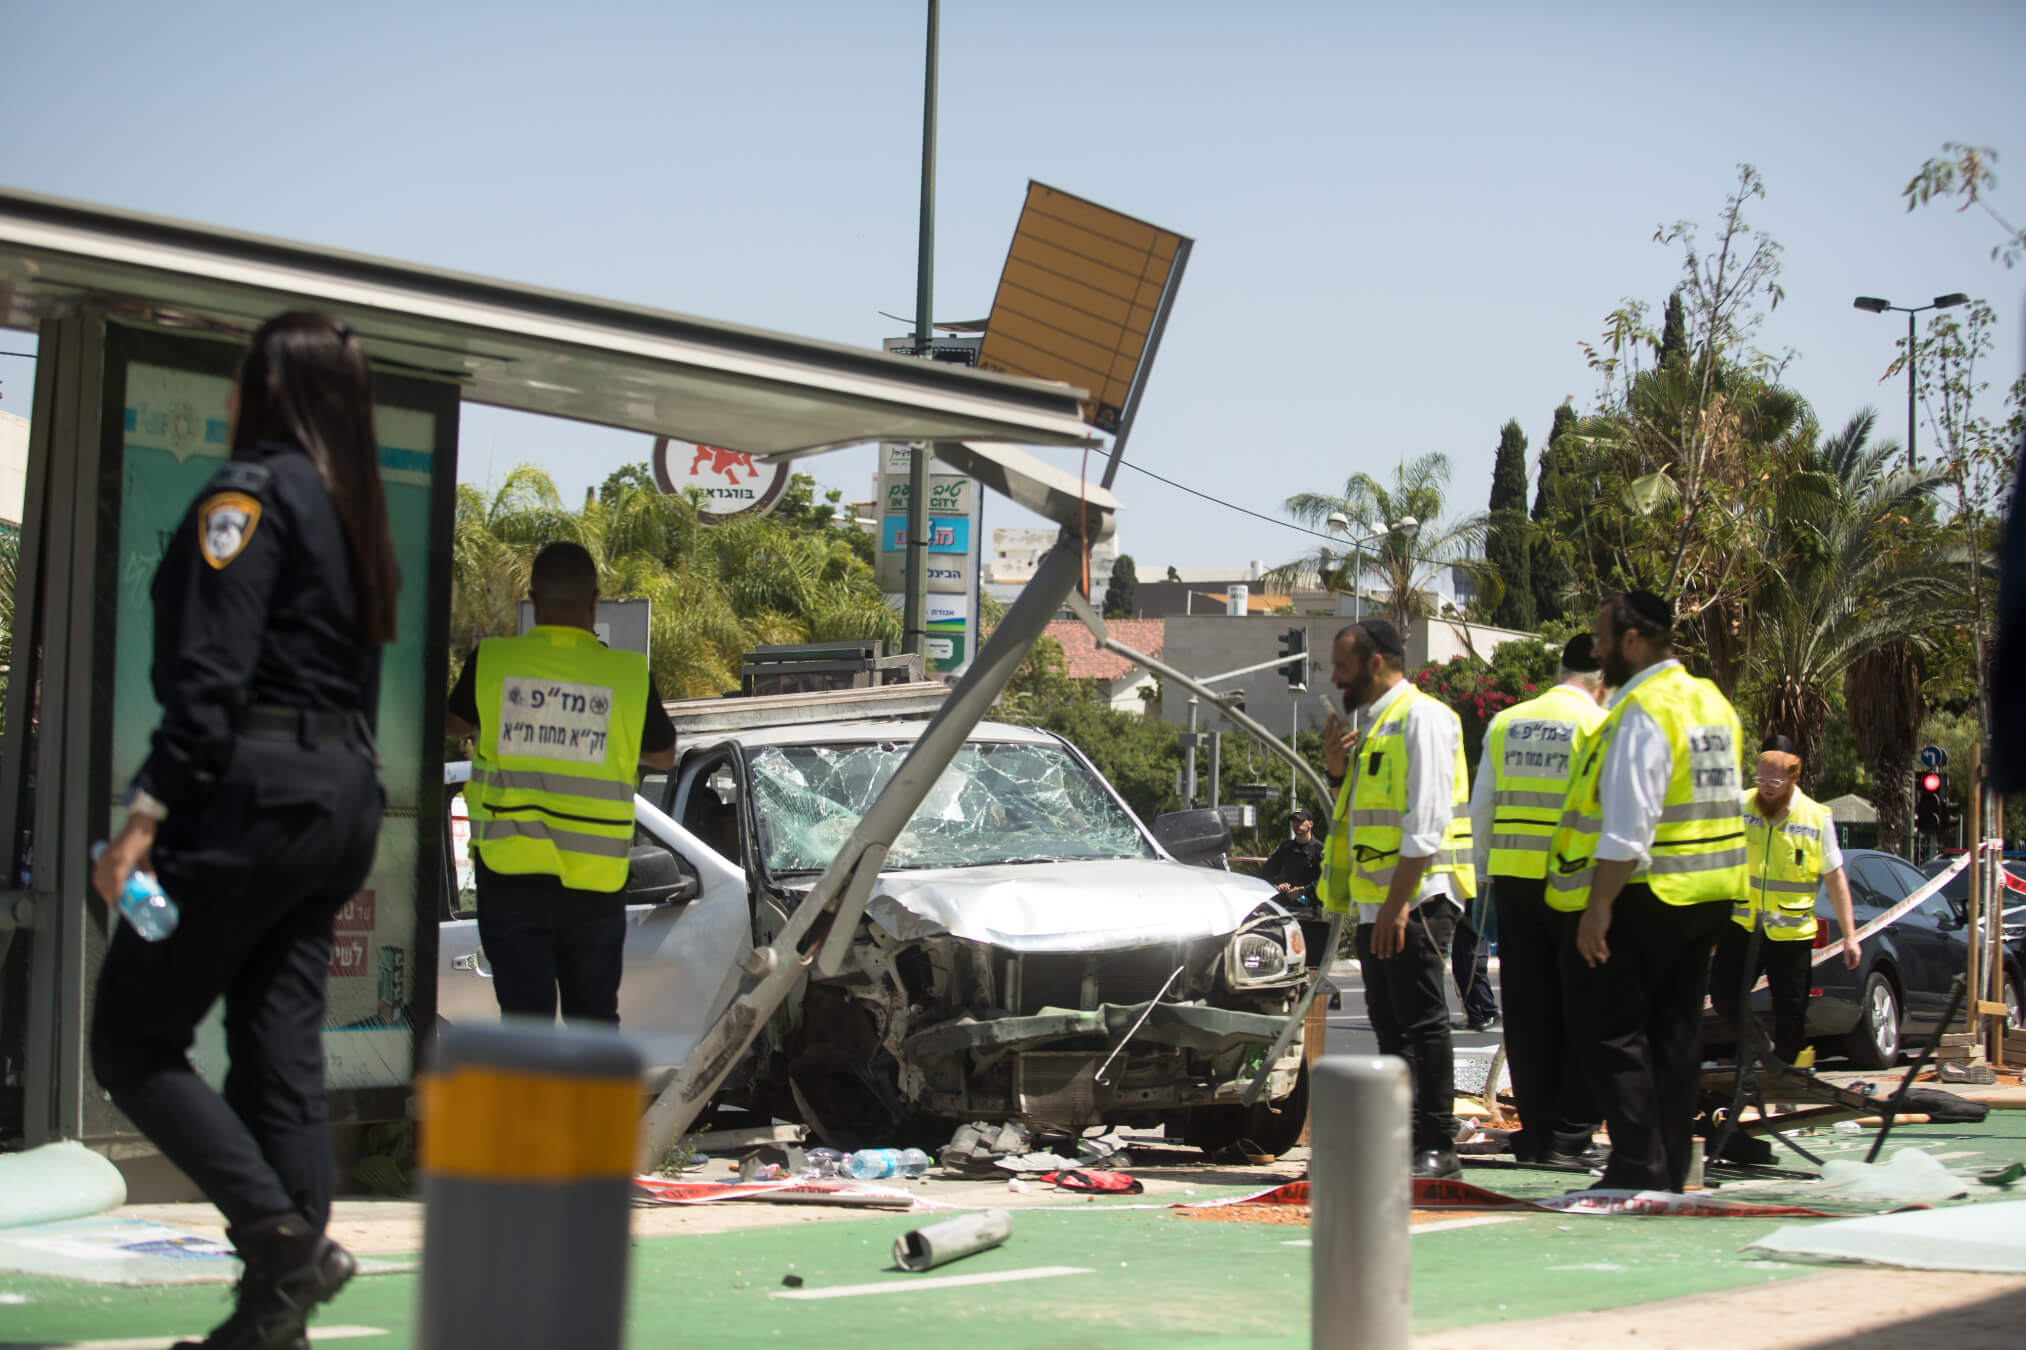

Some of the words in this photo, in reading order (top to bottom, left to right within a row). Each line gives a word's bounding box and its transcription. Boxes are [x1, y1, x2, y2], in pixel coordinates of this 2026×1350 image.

[531, 687, 586, 713] מז"פ
[503, 721, 534, 743] ת"א
[539, 725, 567, 745] מחוז
[569, 728, 606, 755] זק"א
